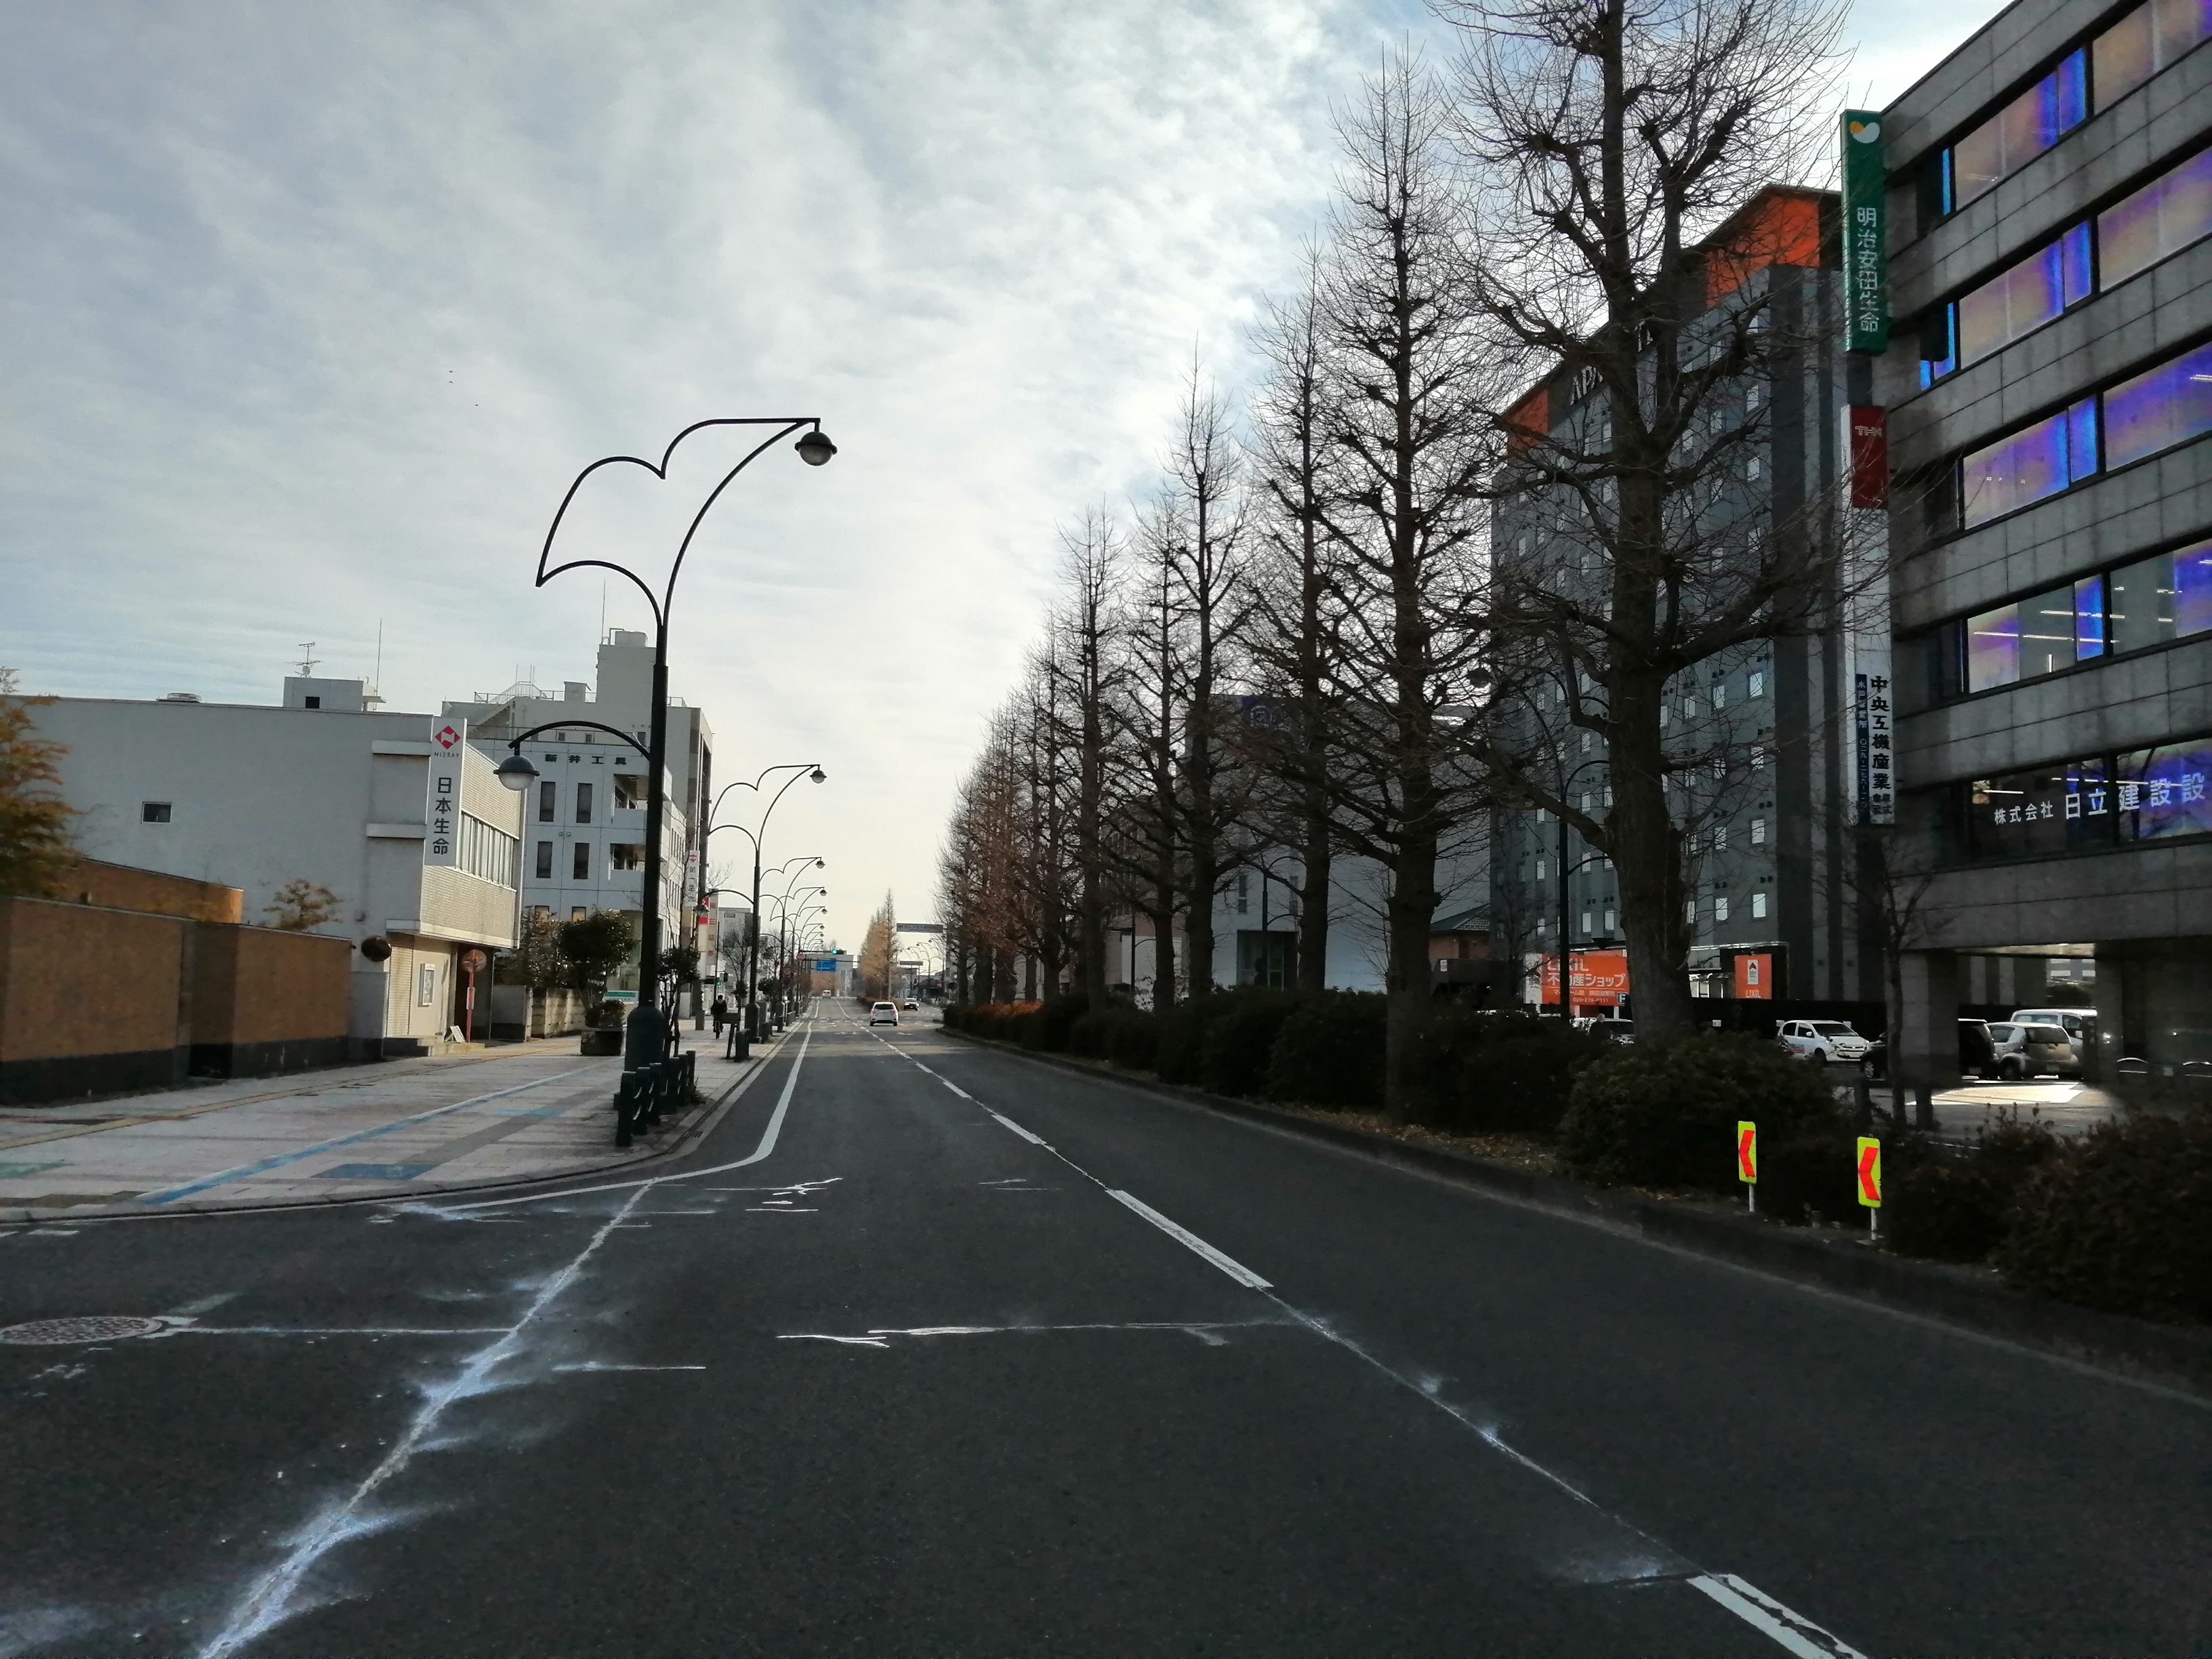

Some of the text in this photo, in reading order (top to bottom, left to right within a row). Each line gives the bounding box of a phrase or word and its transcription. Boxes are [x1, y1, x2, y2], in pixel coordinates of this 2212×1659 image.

[1857, 207, 1880, 333] 明治安田生命
[1870, 676, 1891, 790] 中央工機産業
[432, 777, 452, 855] 日本生命
[1994, 800, 2054, 825] 株式会社
